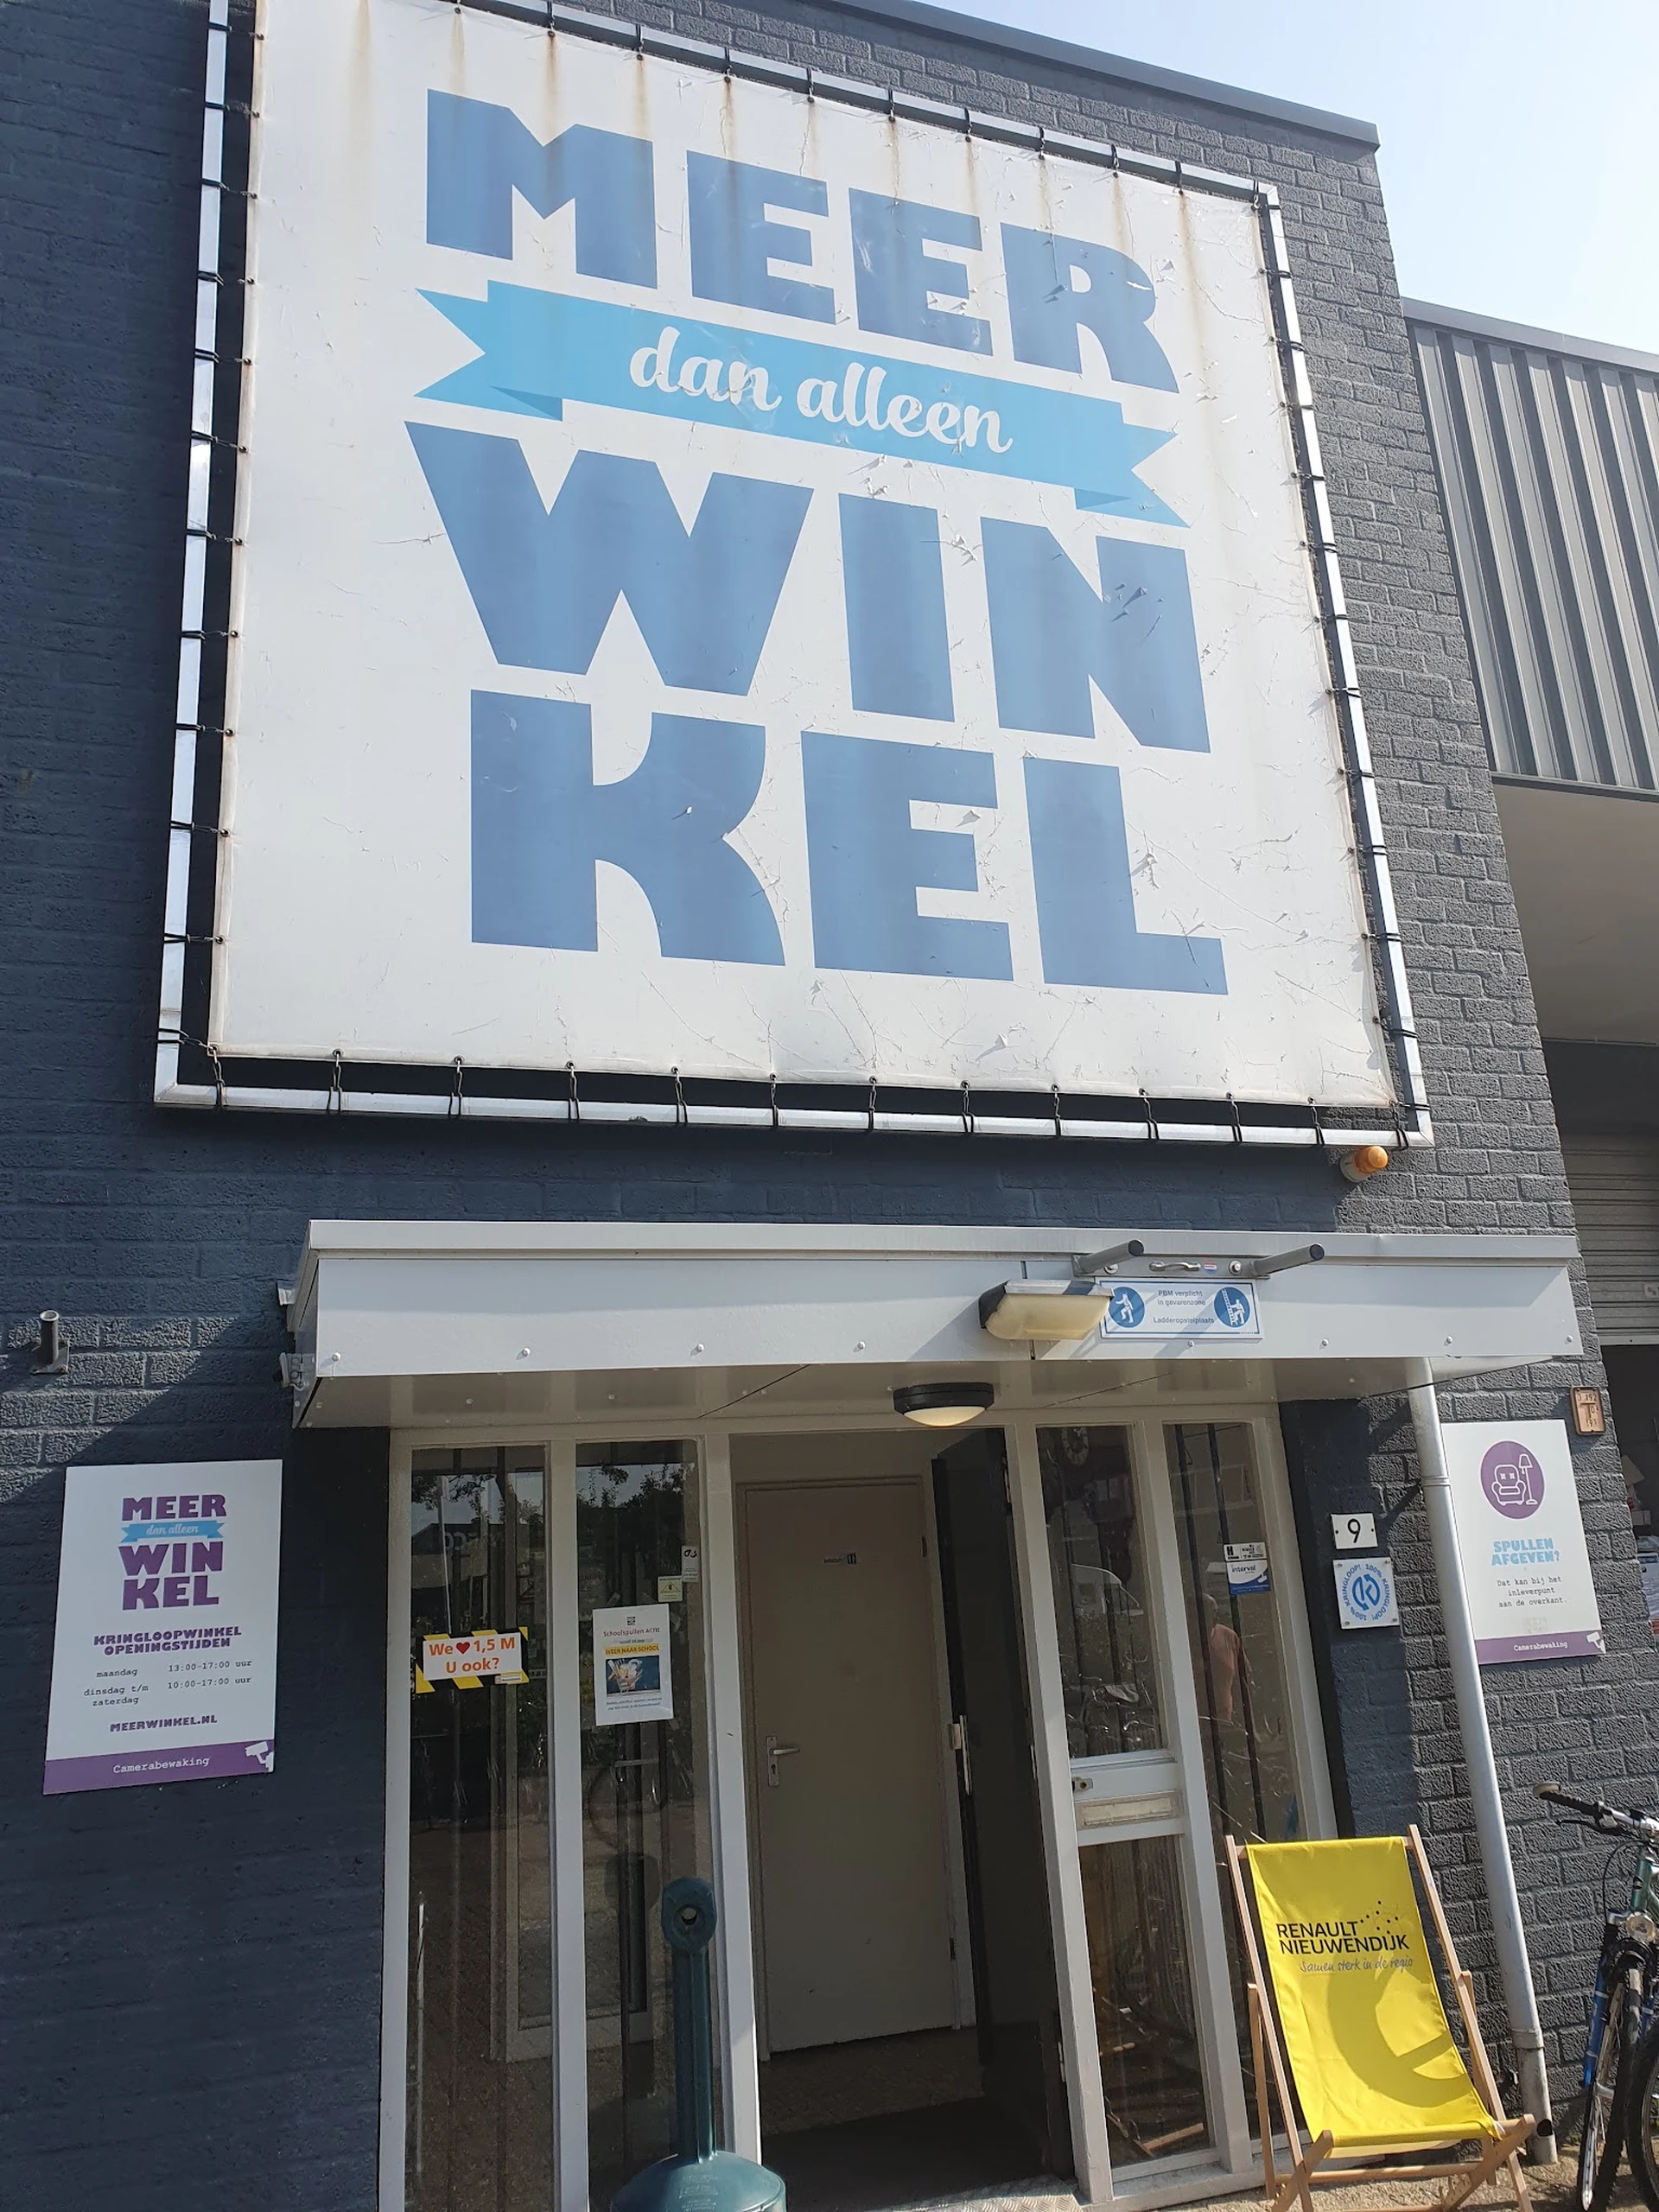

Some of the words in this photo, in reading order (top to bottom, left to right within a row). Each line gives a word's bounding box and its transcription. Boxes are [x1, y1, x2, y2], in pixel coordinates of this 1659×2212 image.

[427, 88, 1179, 393] MEER
[630, 326, 783, 412] dan
[797, 363, 1014, 454] alleen
[404, 421, 1211, 754] WIN
[471, 689, 1228, 996] KEL
[122, 1494, 227, 1522] MEER
[146, 1524, 167, 1535] dan
[168, 1523, 200, 1535] alleen
[1347, 1518, 1361, 1543] 9
[1493, 1537, 1554, 1553] SPULLEN
[118, 1541, 223, 1576] WIN
[1491, 1550, 1560, 1566] AFGEVEN?
[1365, 1563, 1382, 1578] 100%
[1531, 1577, 1545, 1586] bij
[122, 1575, 219, 1611] KEL
[1508, 1587, 1556, 1596] inleverpunt
[1529, 1597, 1567, 1605] overkant.
[93, 1626, 242, 1646] KRINGLOOPWINKEL
[105, 1637, 231, 1656] OPENINGSTIJDEN
[429, 1643, 454, 1656] We
[474, 1638, 495, 1653] 1,5
[500, 1637, 515, 1649] M
[1514, 1640, 1568, 1652] Camerabewaking
[96, 1669, 138, 1678] maandag
[168, 1660, 230, 1673] 13:00-17:00
[446, 1661, 456, 1674] U
[461, 1657, 499, 1672] ook?
[83, 1686, 125, 1696] dinsdag
[131, 1684, 149, 1693] t/m
[168, 1677, 230, 1689] 10:00-17:00
[92, 1696, 139, 1707] zaterdag
[110, 1714, 218, 1732] MEERWINKEL.NL
[113, 1755, 210, 1774] Camerabewaking
[1275, 1920, 1358, 1938] RENAULT
[1279, 1934, 1410, 1955] NIEUWENDIJK
[1300, 1961, 1335, 1974] Samen
[1338, 1958, 1361, 1971] sterk
[1363, 1958, 1372, 1968] in
[1375, 1955, 1389, 1968] de
[1390, 1955, 1414, 1974] regio
